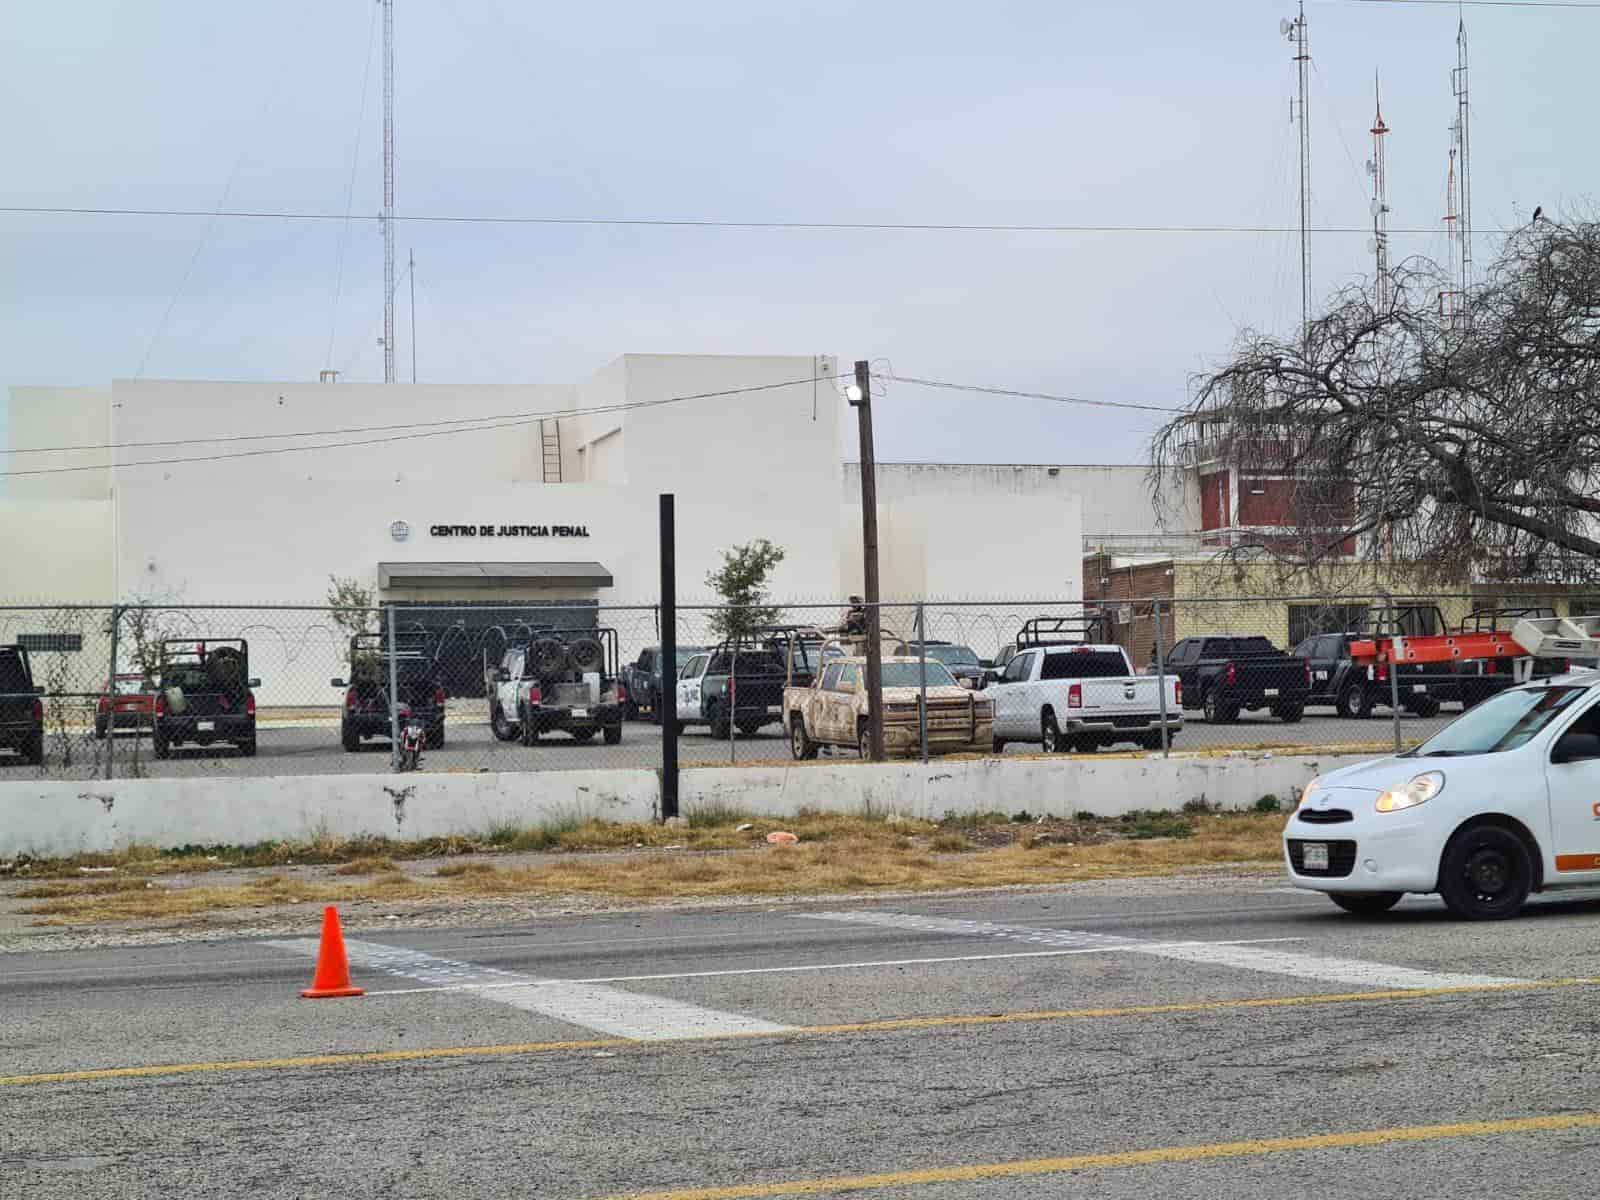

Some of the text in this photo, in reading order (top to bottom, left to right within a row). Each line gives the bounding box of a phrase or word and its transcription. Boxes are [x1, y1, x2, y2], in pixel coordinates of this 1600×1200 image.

[430, 525, 590, 537] CENTRO DE JUSTICIA PENAL
